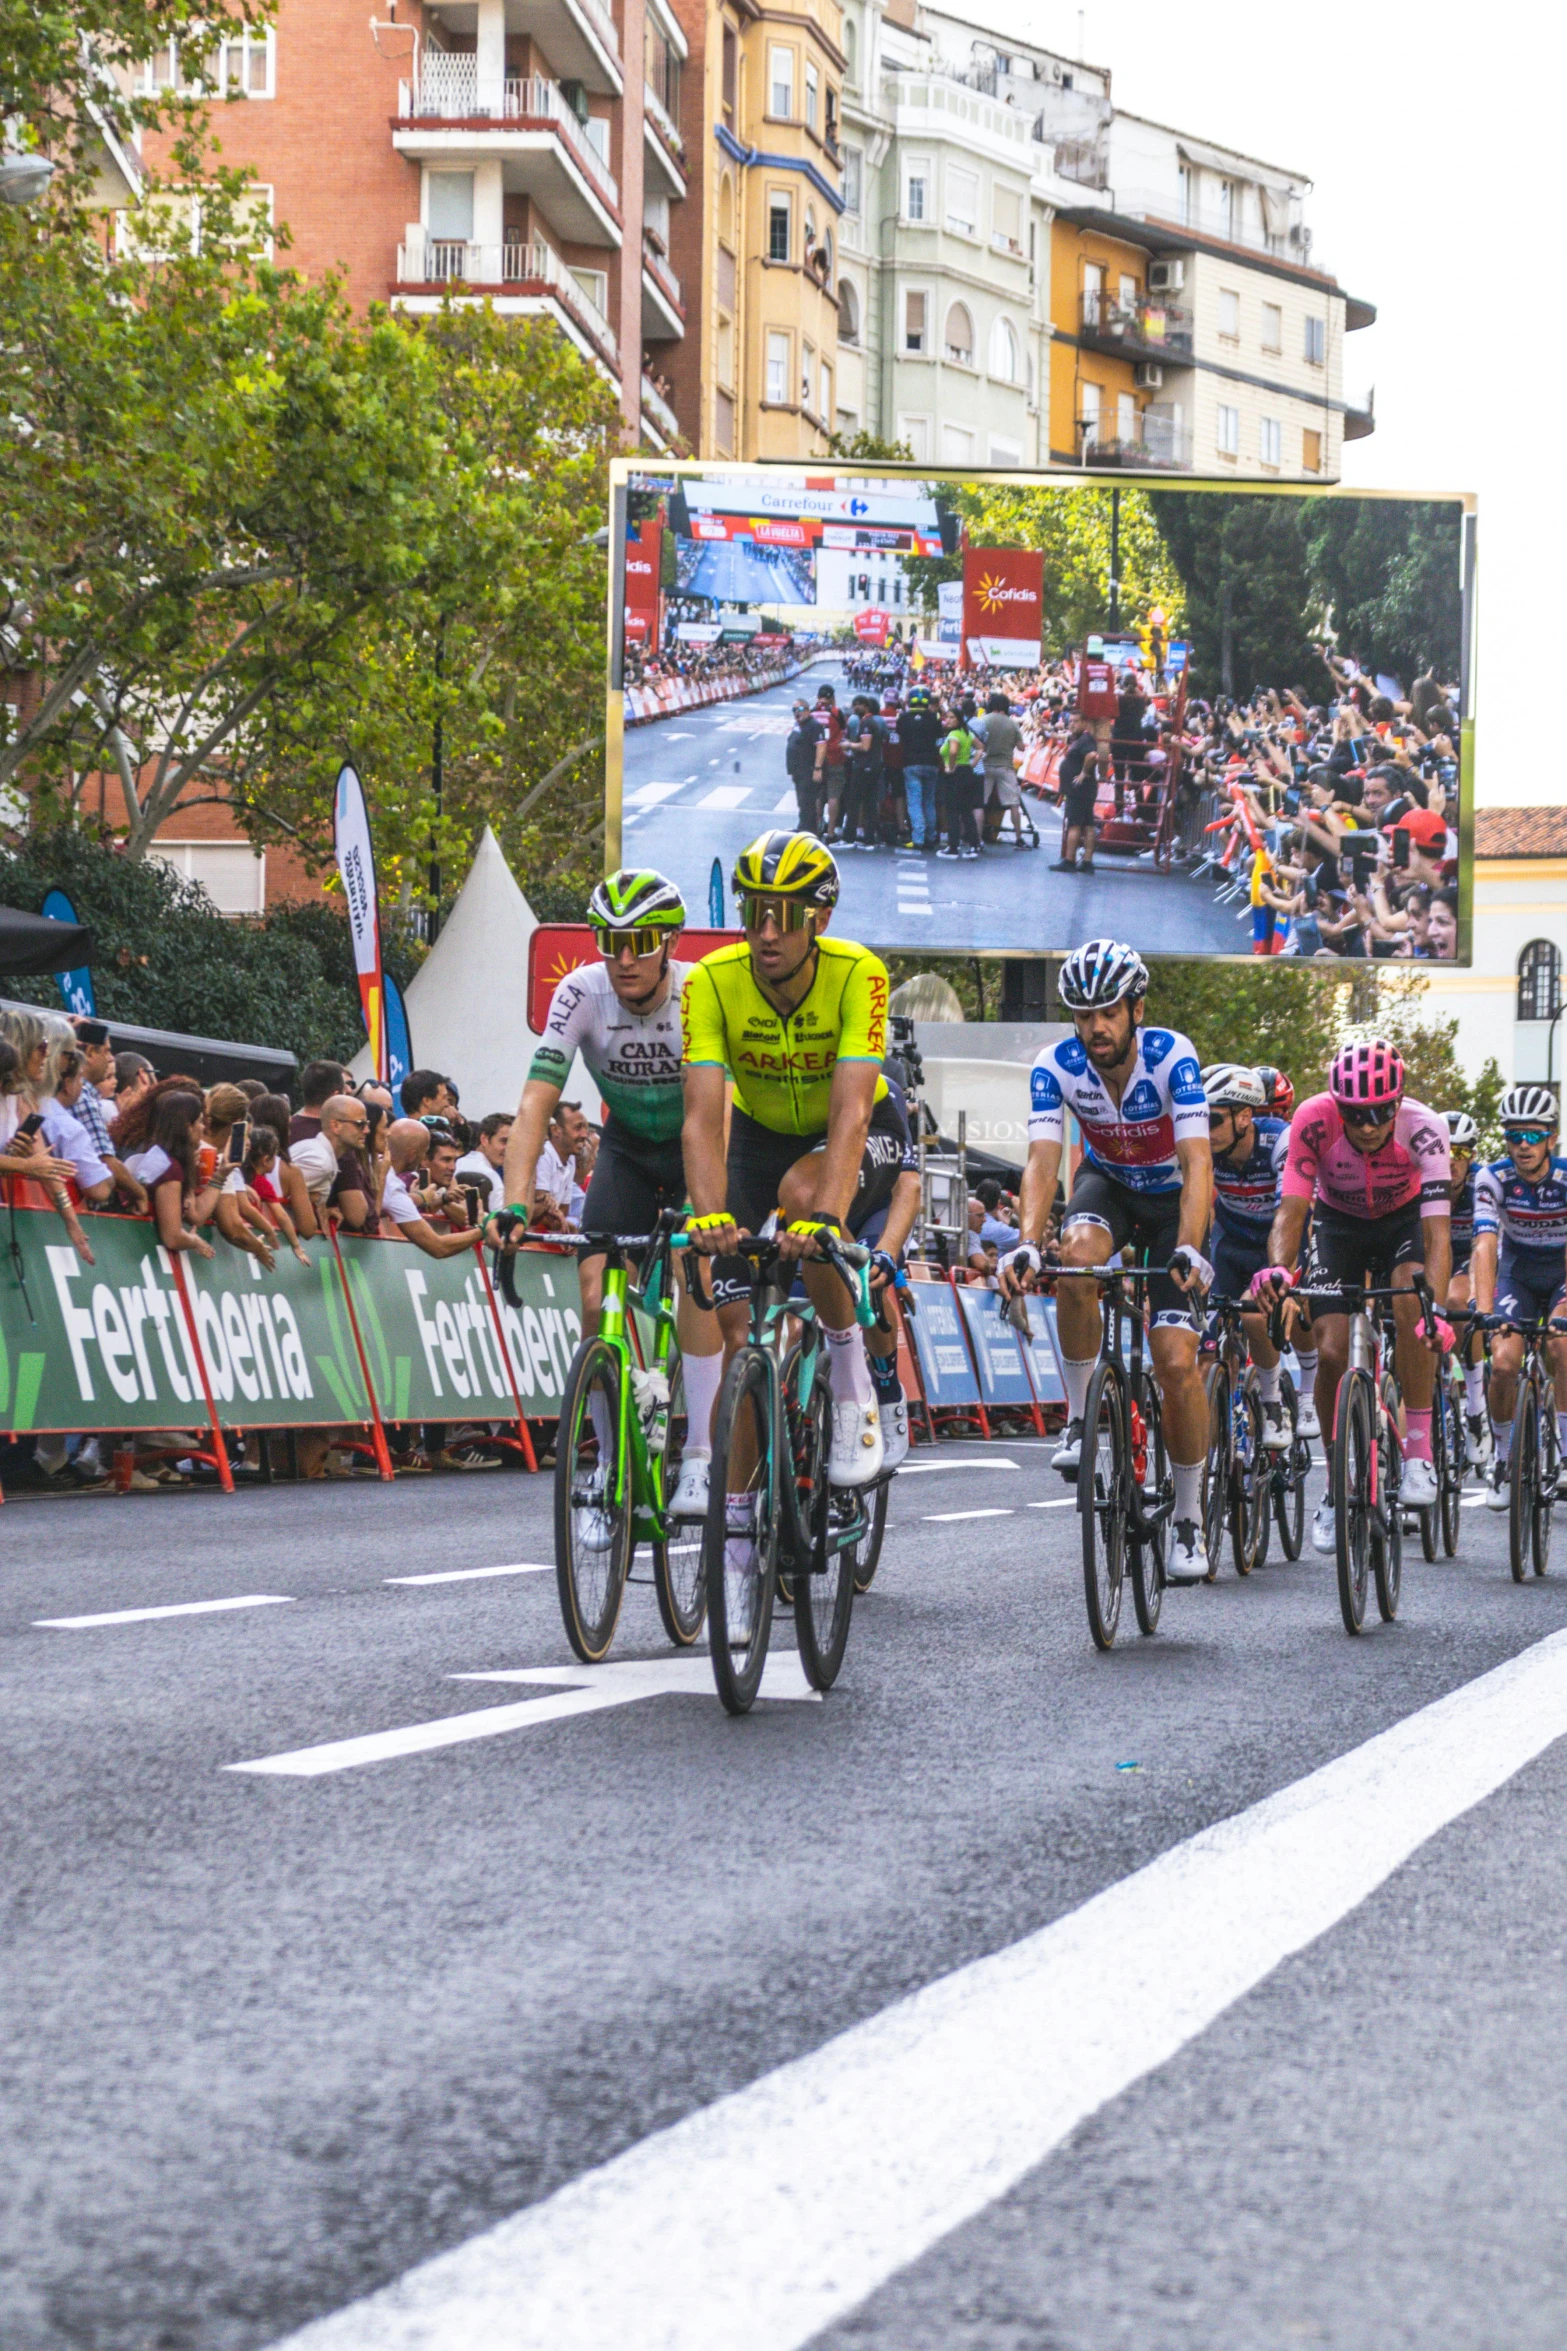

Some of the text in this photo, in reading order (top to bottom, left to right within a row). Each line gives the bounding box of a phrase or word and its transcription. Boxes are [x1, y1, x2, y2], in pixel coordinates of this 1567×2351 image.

[761, 493, 833, 512] Carrefour
[988, 587, 1038, 602] Cofidis
[549, 984, 586, 1036] ALEA
[867, 976, 886, 1053] ARKEA
[620, 1043, 675, 1058] CAJA
[737, 1050, 838, 1071] ARKEA
[1222, 1088, 1263, 1106] SPECIALIZED
[940, 1120, 1029, 1140] VSION
[1086, 1123, 1160, 1138] Cofidis
[45, 1245, 314, 1403] Fertiberia
[404, 1267, 582, 1399] Fertiberia
[1107, 1306, 1116, 1352] LOOK
